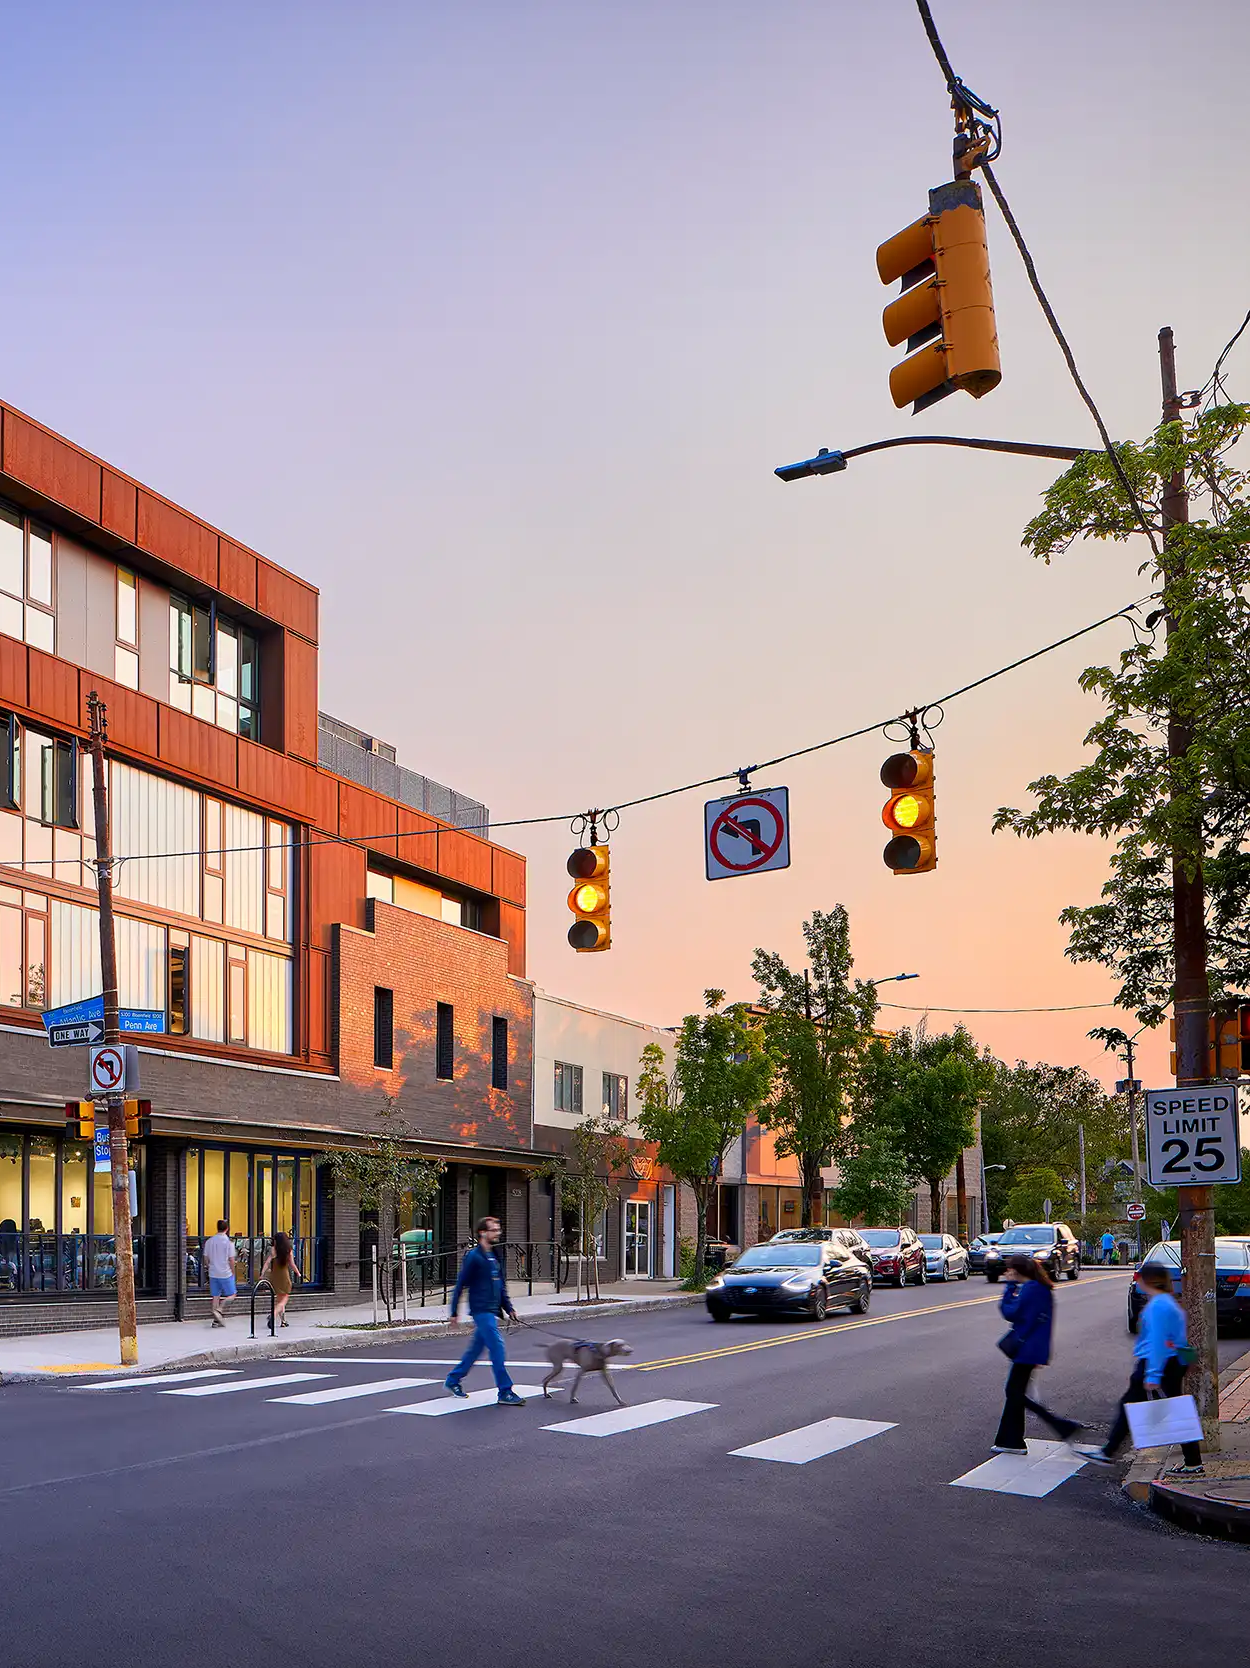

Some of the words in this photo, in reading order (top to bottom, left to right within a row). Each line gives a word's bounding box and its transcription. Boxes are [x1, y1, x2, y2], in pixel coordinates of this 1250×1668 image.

[88, 1009, 101, 1019] Ave
[124, 1020, 142, 1030] Penn
[144, 1021, 158, 1031] Ave
[55, 1030, 70, 1041] ONE
[73, 1028, 89, 1039] WAY
[1153, 1096, 1229, 1116] SPEED
[1163, 1117, 1220, 1134] LIMIT
[96, 1132, 110, 1143] Bus
[1161, 1136, 1225, 1174] 25
